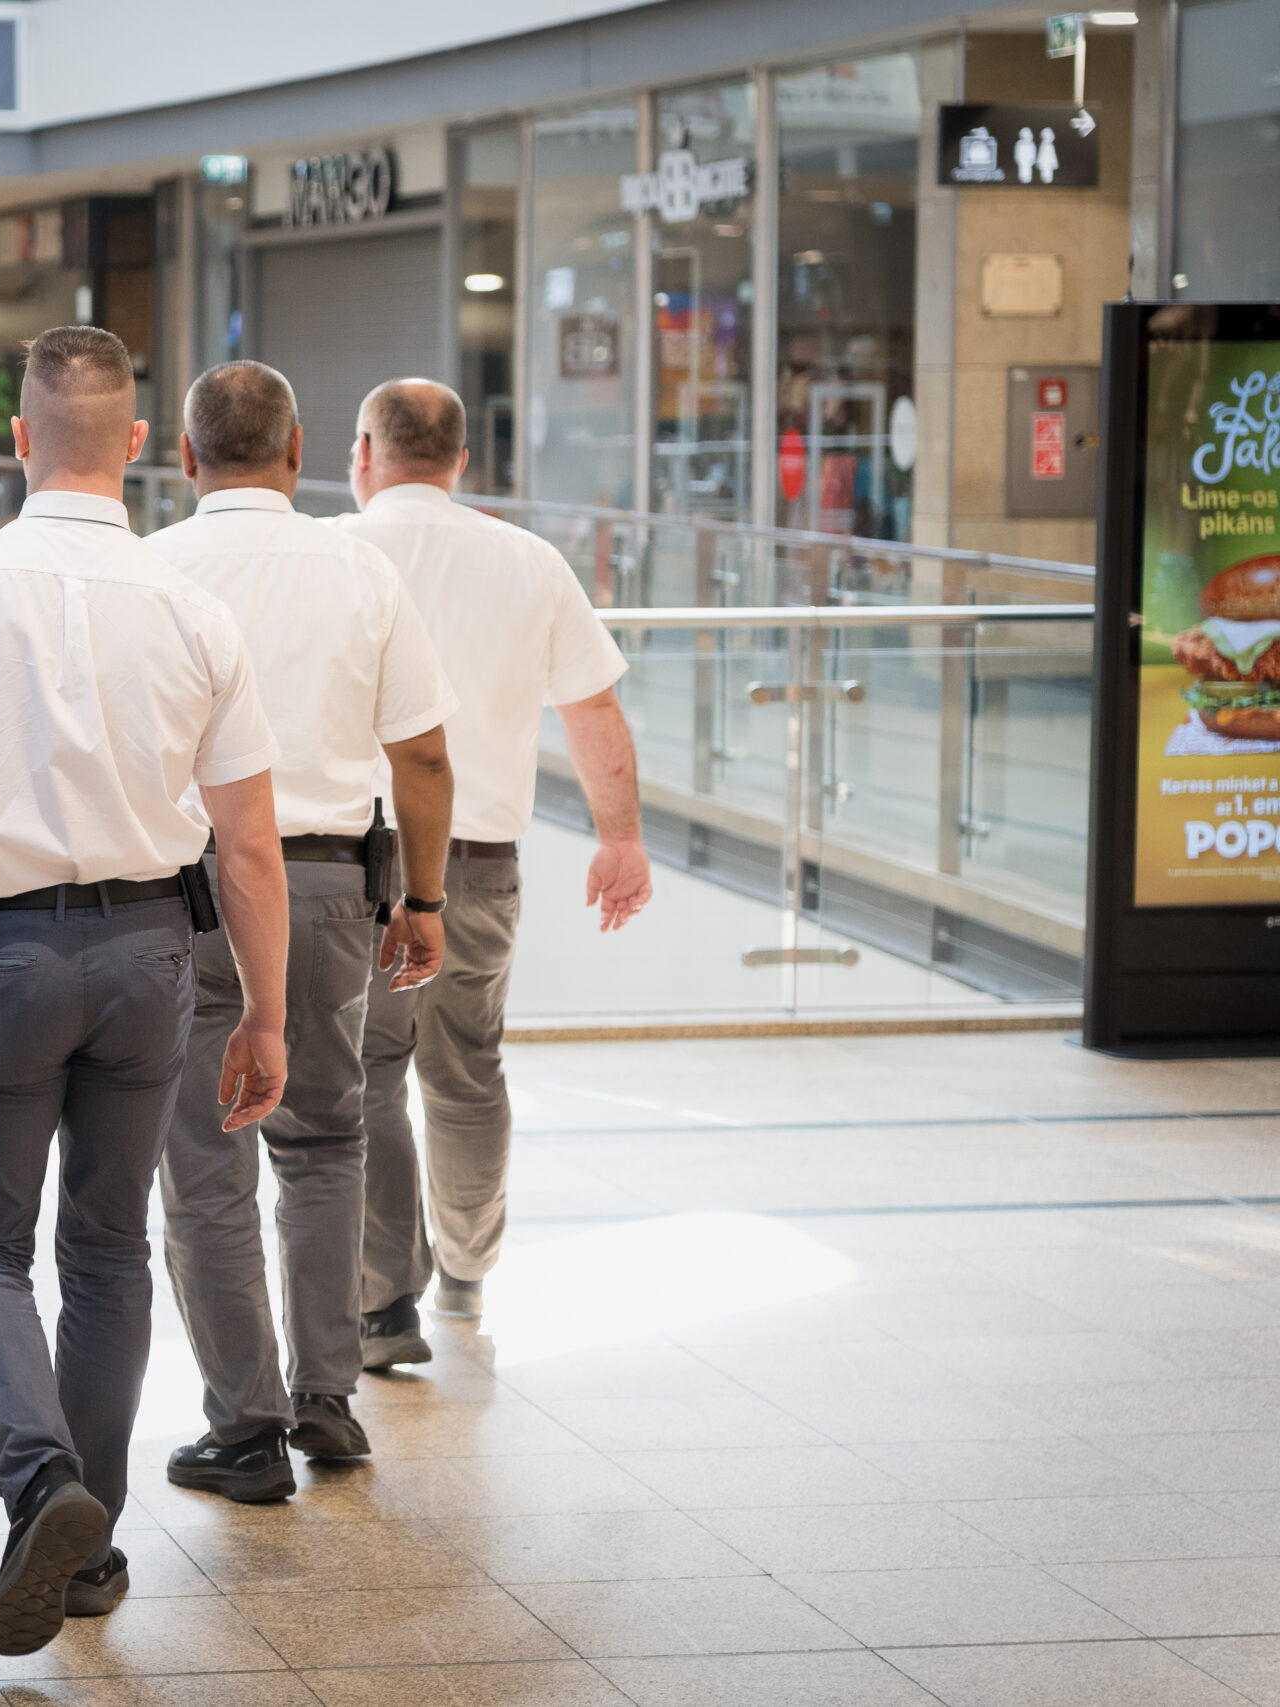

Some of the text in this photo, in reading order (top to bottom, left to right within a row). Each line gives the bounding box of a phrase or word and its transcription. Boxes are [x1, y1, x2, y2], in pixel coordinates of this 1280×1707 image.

[287, 148, 393, 228] MANGO
[1181, 483, 1278, 509] Lime-os
[1199, 511, 1275, 538] pikáns
[1161, 776, 1278, 794] Keress minket a
[1234, 794, 1249, 815] 1.
[1184, 820, 1280, 859] POP
